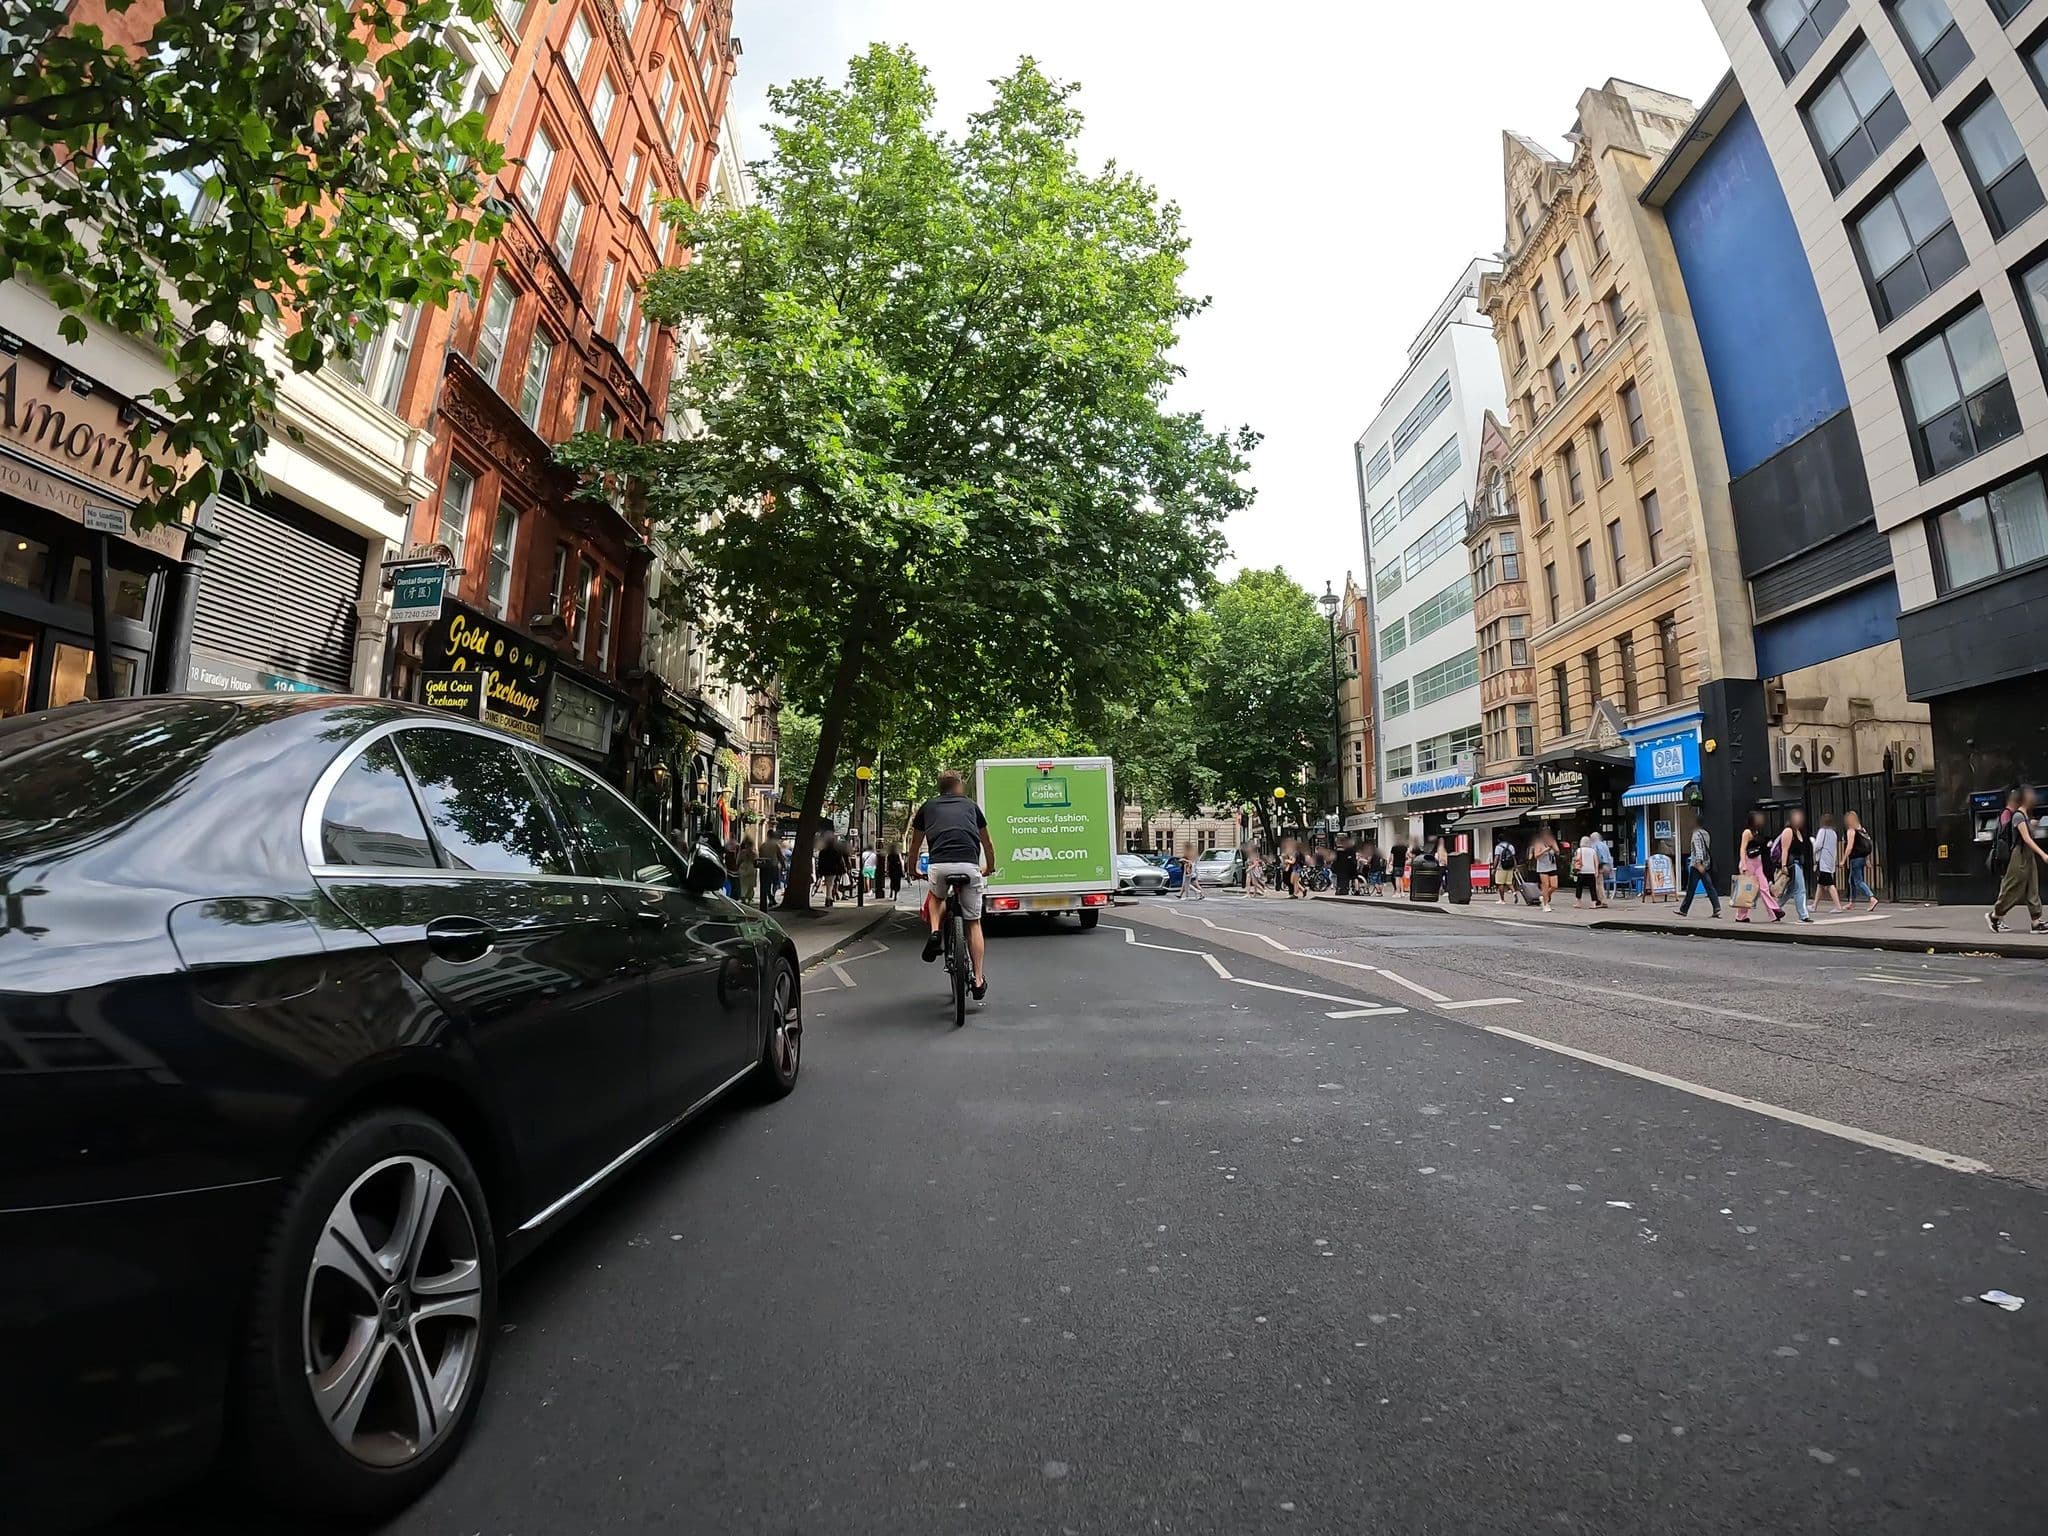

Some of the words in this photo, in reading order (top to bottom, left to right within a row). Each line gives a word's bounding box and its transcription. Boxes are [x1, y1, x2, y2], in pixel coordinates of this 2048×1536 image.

[23, 476, 41, 494] AL
[87, 509, 97, 517] No
[99, 511, 123, 523] loading
[96, 521, 107, 530] any
[109, 522, 123, 531] time
[397, 578, 417, 586] Dental
[417, 576, 441, 585] Surgery
[445, 614, 490, 656] Gold
[190, 666, 199, 680] 18
[200, 669, 230, 690] Faraday
[230, 675, 252, 691] House
[426, 680, 448, 697] Gold
[450, 680, 473, 693] Coin
[486, 670, 540, 718] Exchange
[427, 694, 469, 708] Exchange
[527, 723, 541, 735] SOLD
[1655, 749, 1681, 768] OPA
[1435, 774, 1467, 791] LONDON
[1546, 771, 1583, 785] Maharaja
[1032, 791, 1063, 799] Collect
[1509, 785, 1536, 793] INDIAN
[1509, 796, 1537, 804] CUISINE
[1006, 814, 1053, 824] Groceries,
[1054, 813, 1090, 823] fashion,
[1011, 825, 1038, 834] home
[1041, 824, 1058, 833] and
[1060, 825, 1085, 833] more
[1655, 821, 1670, 832] OPA
